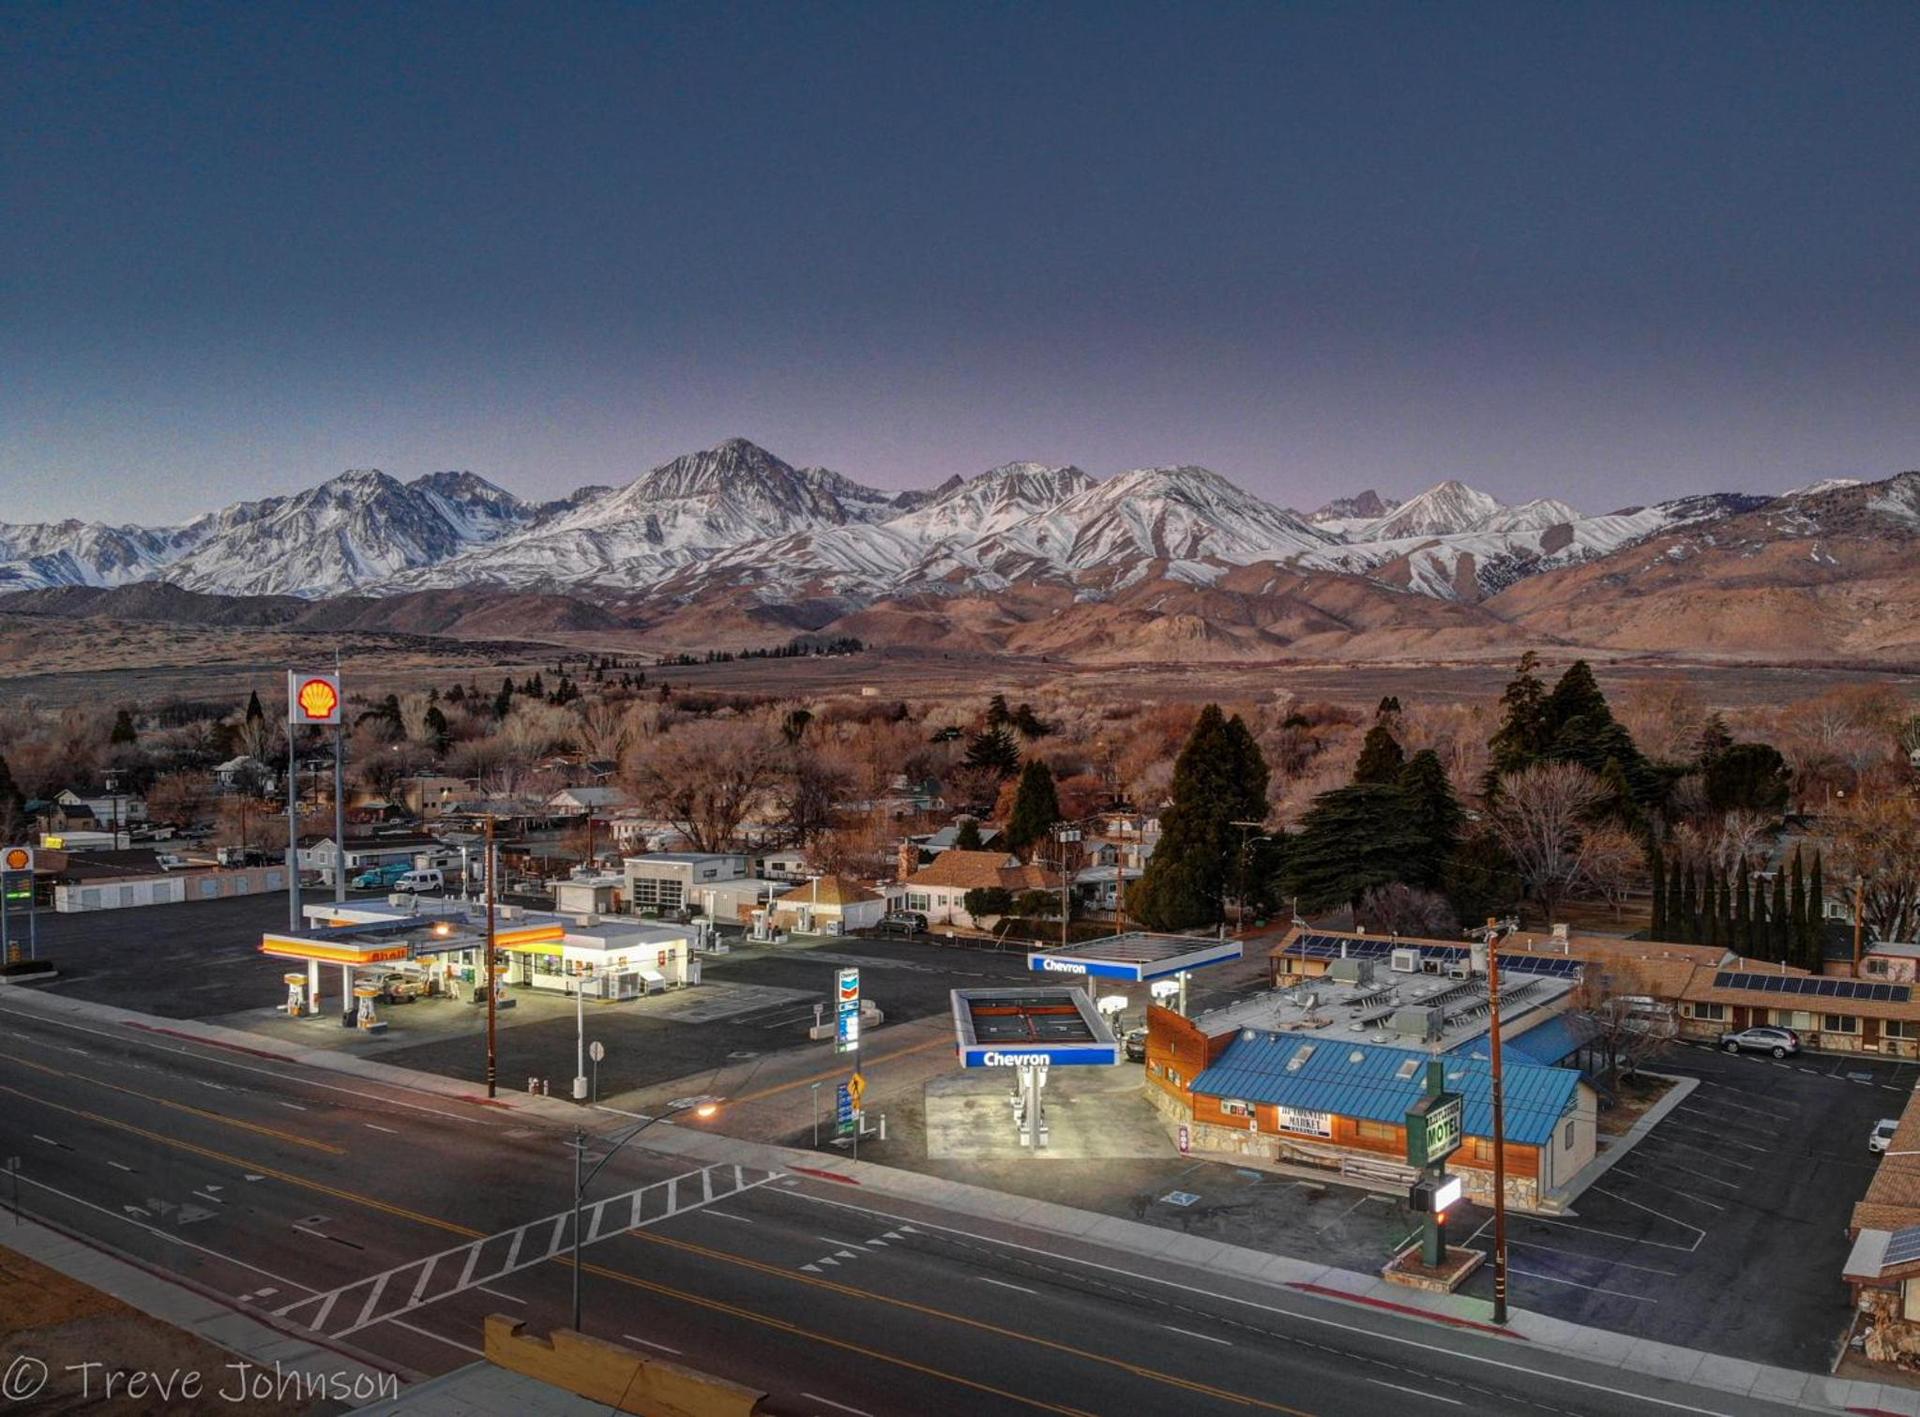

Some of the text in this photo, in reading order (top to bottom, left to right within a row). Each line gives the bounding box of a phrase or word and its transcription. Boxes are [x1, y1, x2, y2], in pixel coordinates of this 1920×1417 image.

[1043, 959, 1086, 974] Chevron
[983, 1052, 1050, 1067] Chevron
[1427, 1114, 1459, 1148] MOTEL
